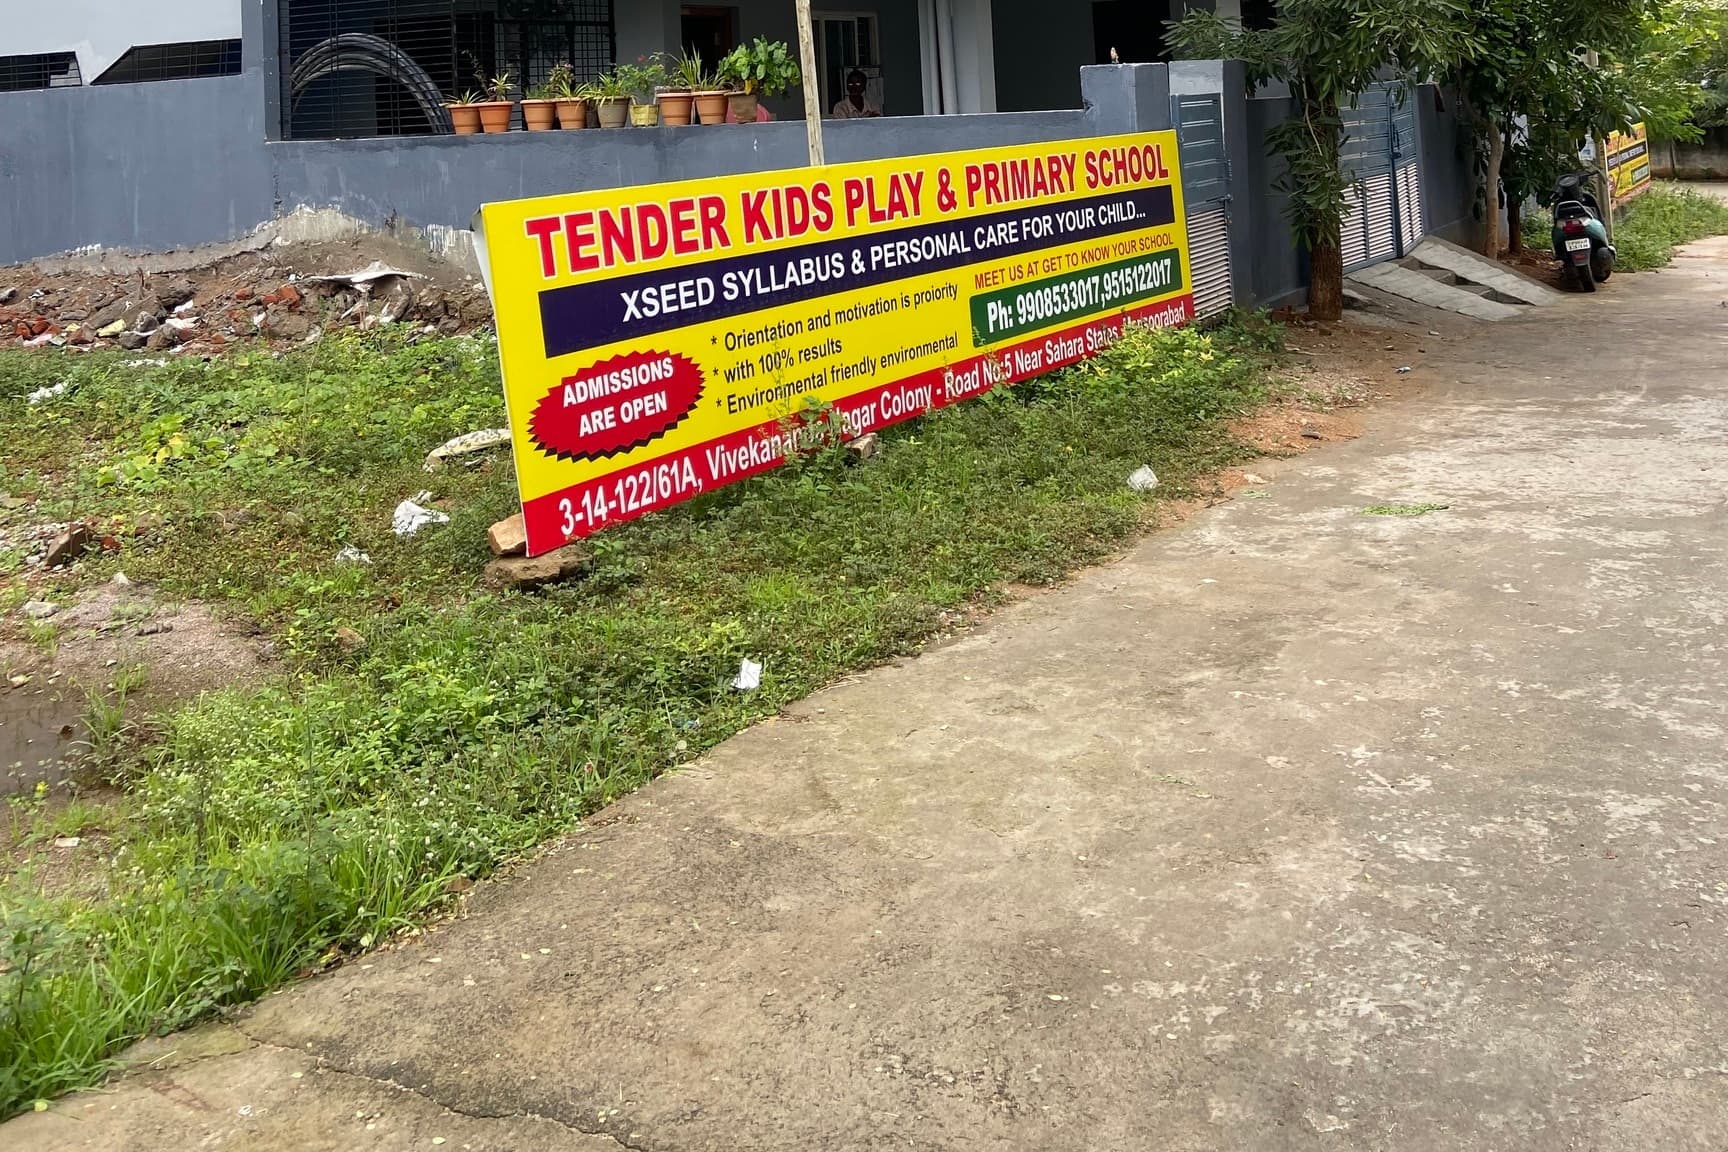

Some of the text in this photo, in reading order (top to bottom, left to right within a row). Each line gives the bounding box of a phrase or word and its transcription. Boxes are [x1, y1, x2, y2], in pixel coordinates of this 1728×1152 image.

[525, 144, 1169, 279] TENDER KIDS PLAY & PRIMARY SCHOOL
[620, 200, 1146, 323] XSEED SYLLABUS & PERSONAL CARE FOR YOUR CHILD...
[974, 232, 1174, 290] MEET US AT GET TO KNOW YOUR SCHOOL
[987, 258, 1172, 334] Ph: 9908533017,9515122017
[724, 283, 959, 352] Orientation and motivation is proiority
[562, 357, 674, 408] ADMISSIONS
[724, 338, 842, 384] with 100% results
[727, 332, 959, 415] Environmental friendly environmental
[558, 456, 703, 536] 3-14-122/61A,
[880, 387, 932, 421] Colony
[944, 361, 980, 399] Road
[1014, 347, 1043, 376] Near
[1045, 335, 1085, 360] Sahara
[579, 391, 668, 438] ARE OPEN
